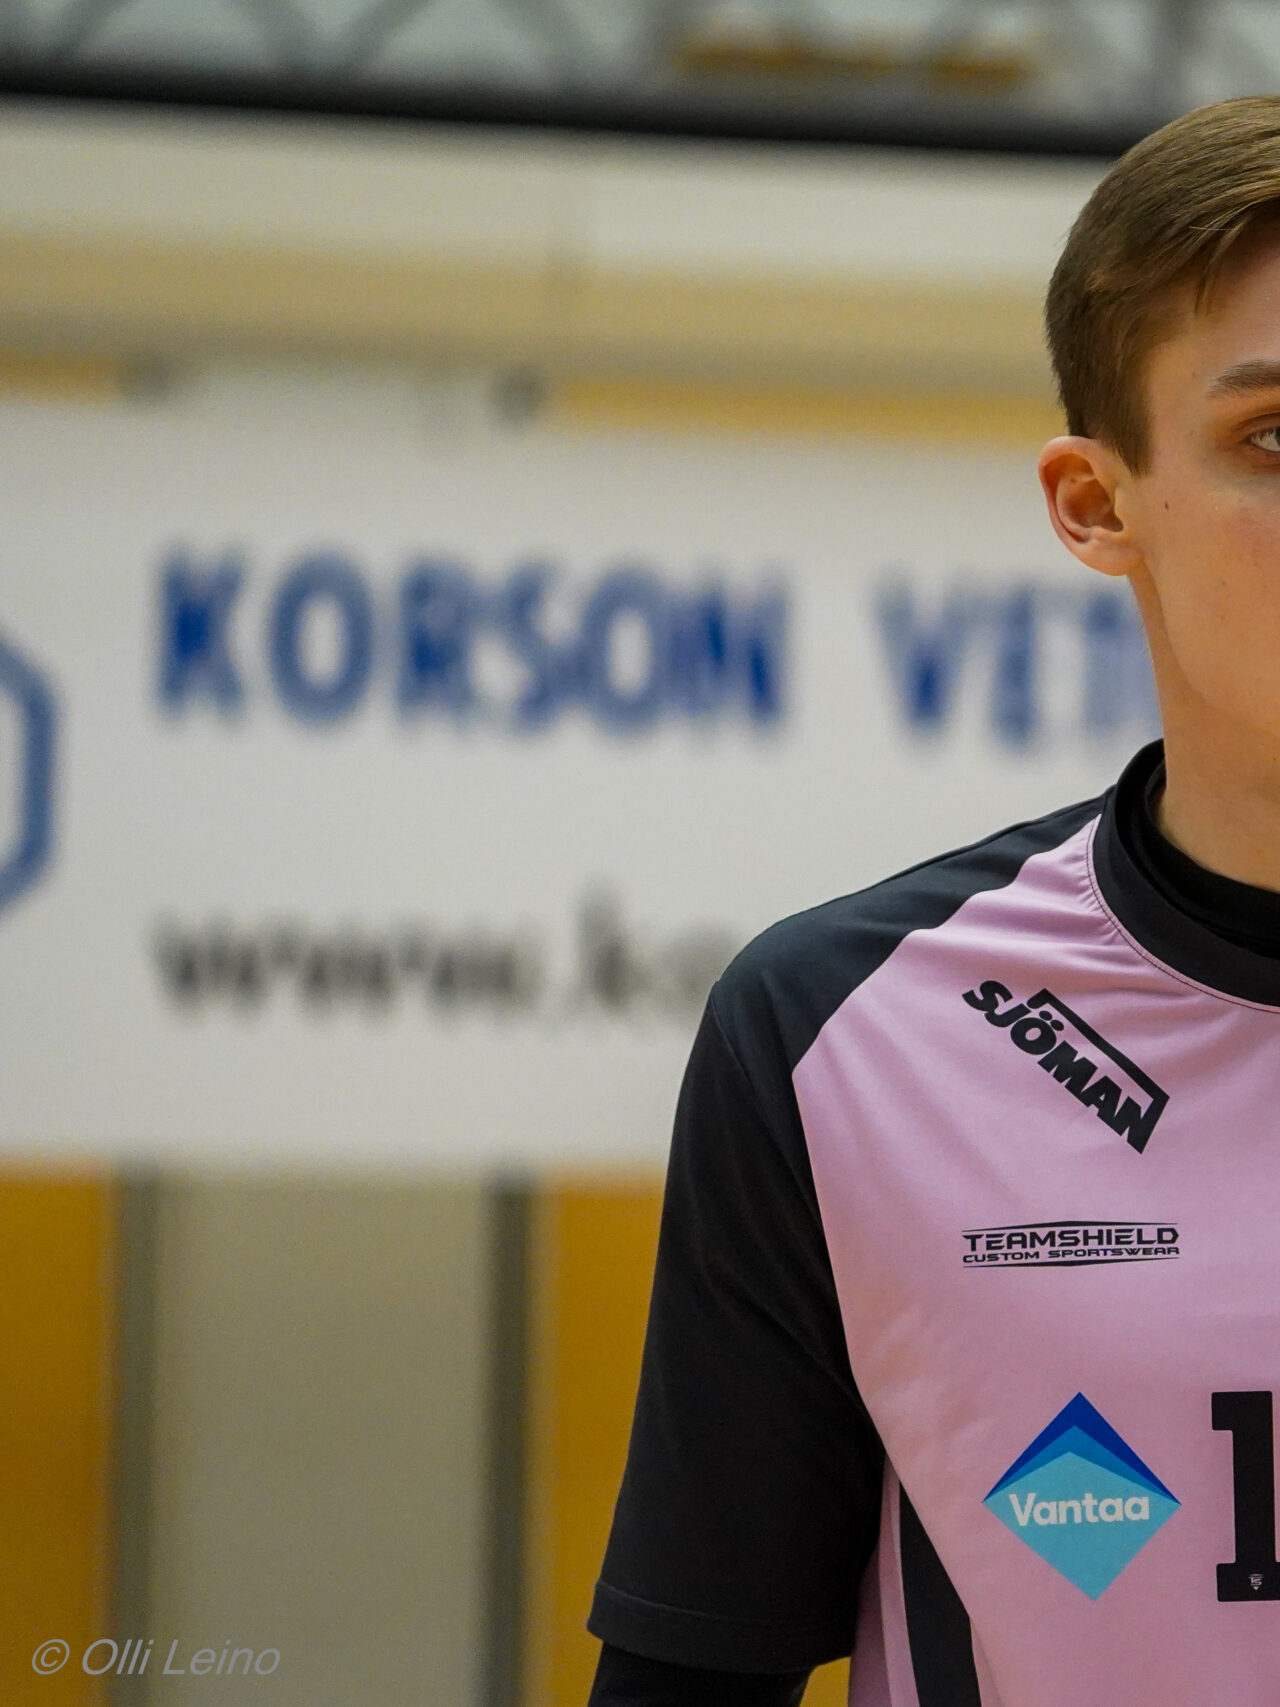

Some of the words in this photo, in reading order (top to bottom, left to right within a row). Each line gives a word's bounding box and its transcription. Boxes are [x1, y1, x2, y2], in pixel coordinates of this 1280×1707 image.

[157, 550, 788, 732] KORSON
[961, 980, 1169, 1153] SJÖMAN
[962, 1228, 1179, 1252] TEAMSHIELD
[963, 1251, 1039, 1263] CUSTOM
[1048, 1247, 1180, 1259] SPORTSWEAR
[1009, 1492, 1150, 1527] Vantaa
